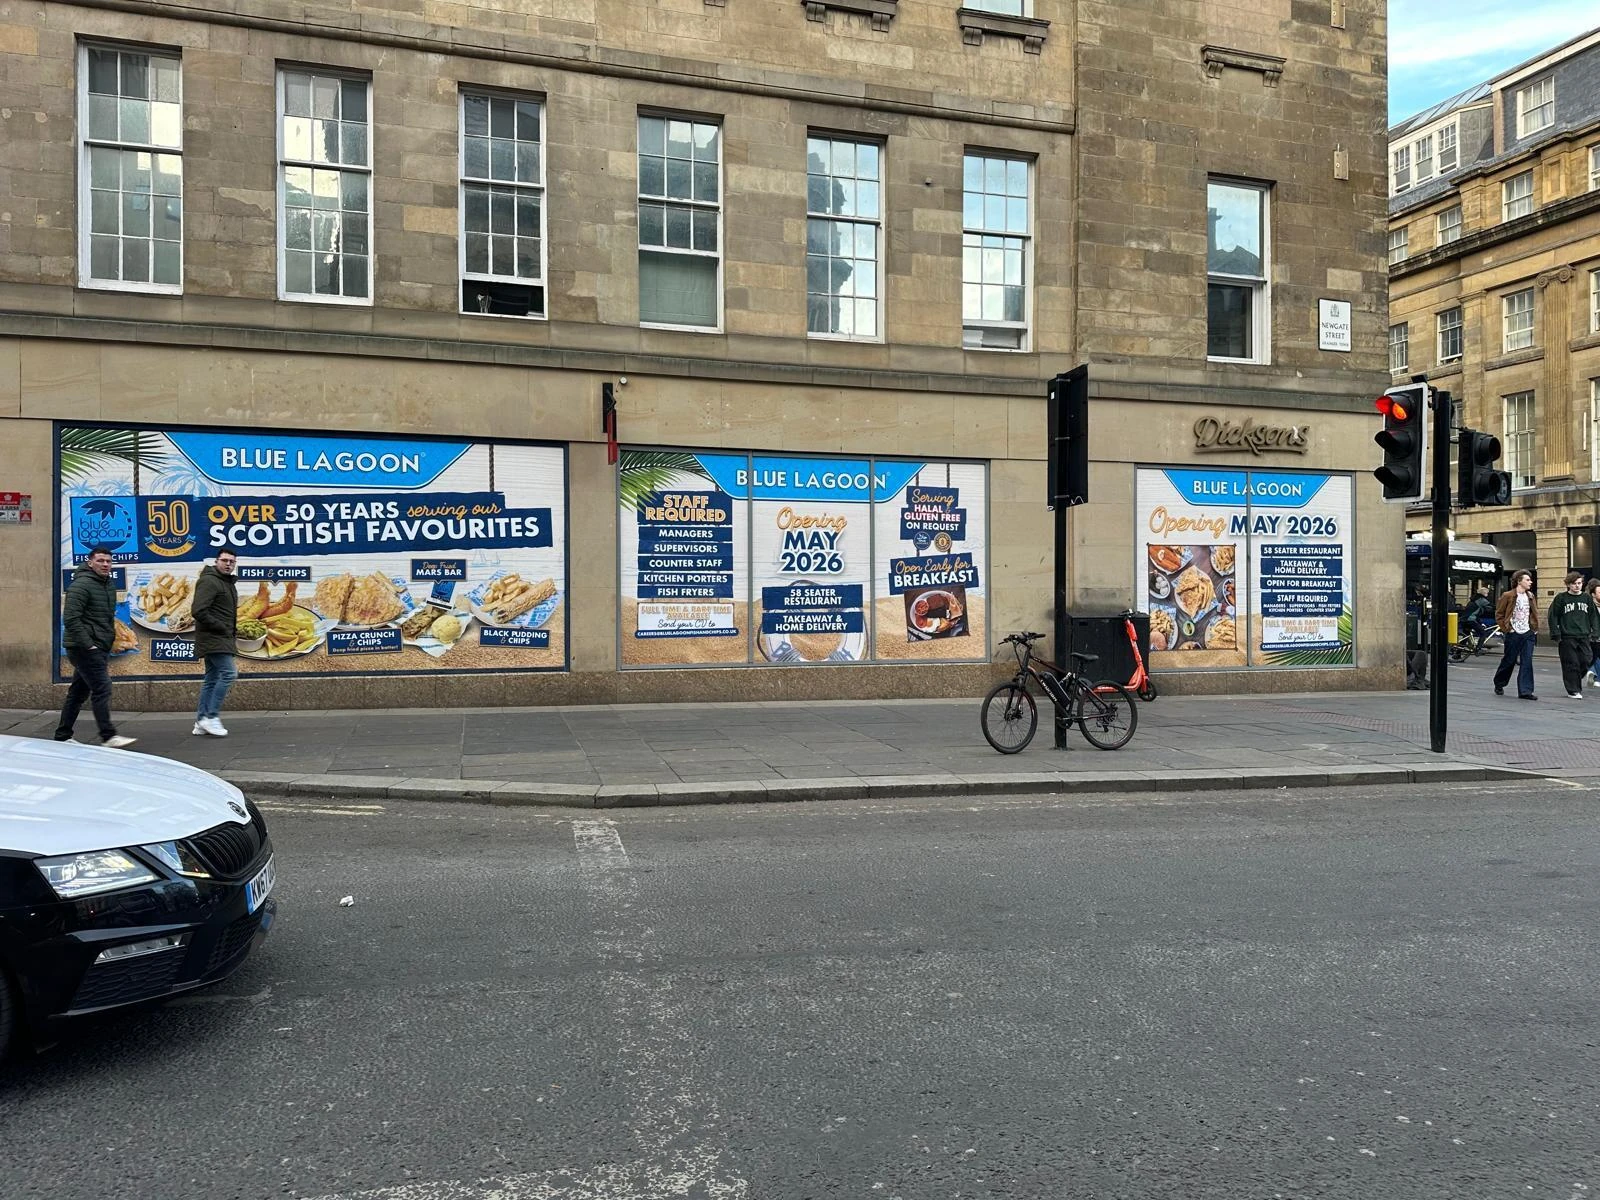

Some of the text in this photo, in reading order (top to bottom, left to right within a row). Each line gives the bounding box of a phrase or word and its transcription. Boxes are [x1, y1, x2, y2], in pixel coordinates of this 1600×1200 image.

[1322, 322, 1349, 330] NEWGATE
[1193, 416, 1310, 455] Dicksons
[222, 448, 419, 473] BLUE LAGOON
[736, 470, 887, 489] BLUE LAGOON
[1193, 481, 1302, 496] BLUE LAGOON
[663, 495, 709, 508] STAFF
[912, 489, 953, 506] Serving
[208, 502, 501, 523] OVER 50 YEARS serving our
[914, 505, 943, 513] HALAL
[148, 500, 190, 537] 50
[645, 507, 726, 522] REQUIRED
[776, 507, 847, 529] Opening
[904, 512, 960, 522] GLUTEN FREE
[80, 518, 110, 530] blue
[906, 522, 959, 530] ON REQUEST
[1149, 506, 1336, 538] Opening MAY 2026
[78, 527, 124, 545] lagoon
[210, 516, 539, 547] SCOTTISH FAVOURITES
[659, 529, 713, 538] MANAGERS
[784, 531, 838, 550] MAY
[654, 544, 718, 553] SUPERVISORS
[649, 559, 722, 568] COUNTER STAFF
[780, 552, 842, 572] 2026
[895, 556, 971, 573] Open Early for
[1280, 560, 1317, 568] TAKEAWAY
[242, 569, 307, 577] FISH & CHIPS
[1275, 566, 1327, 574] HOME DELIVERY
[643, 574, 728, 583] KITCHEN PORTERS
[894, 570, 974, 587] BREAKFAST
[658, 588, 714, 596] FISH FRYERS
[784, 597, 842, 605] RESTAURANT
[642, 606, 660, 614] FULL
[783, 615, 833, 623] TAKEAWAY
[658, 620, 676, 628] Send
[677, 622, 693, 630] your
[695, 619, 707, 628] CV
[775, 622, 848, 631] HOME DELIVERY
[332, 631, 395, 641] PIZZA CRUNCH
[1294, 634, 1306, 642] your
[156, 642, 195, 650] HAGGIS
[357, 638, 381, 646] CHIPS
